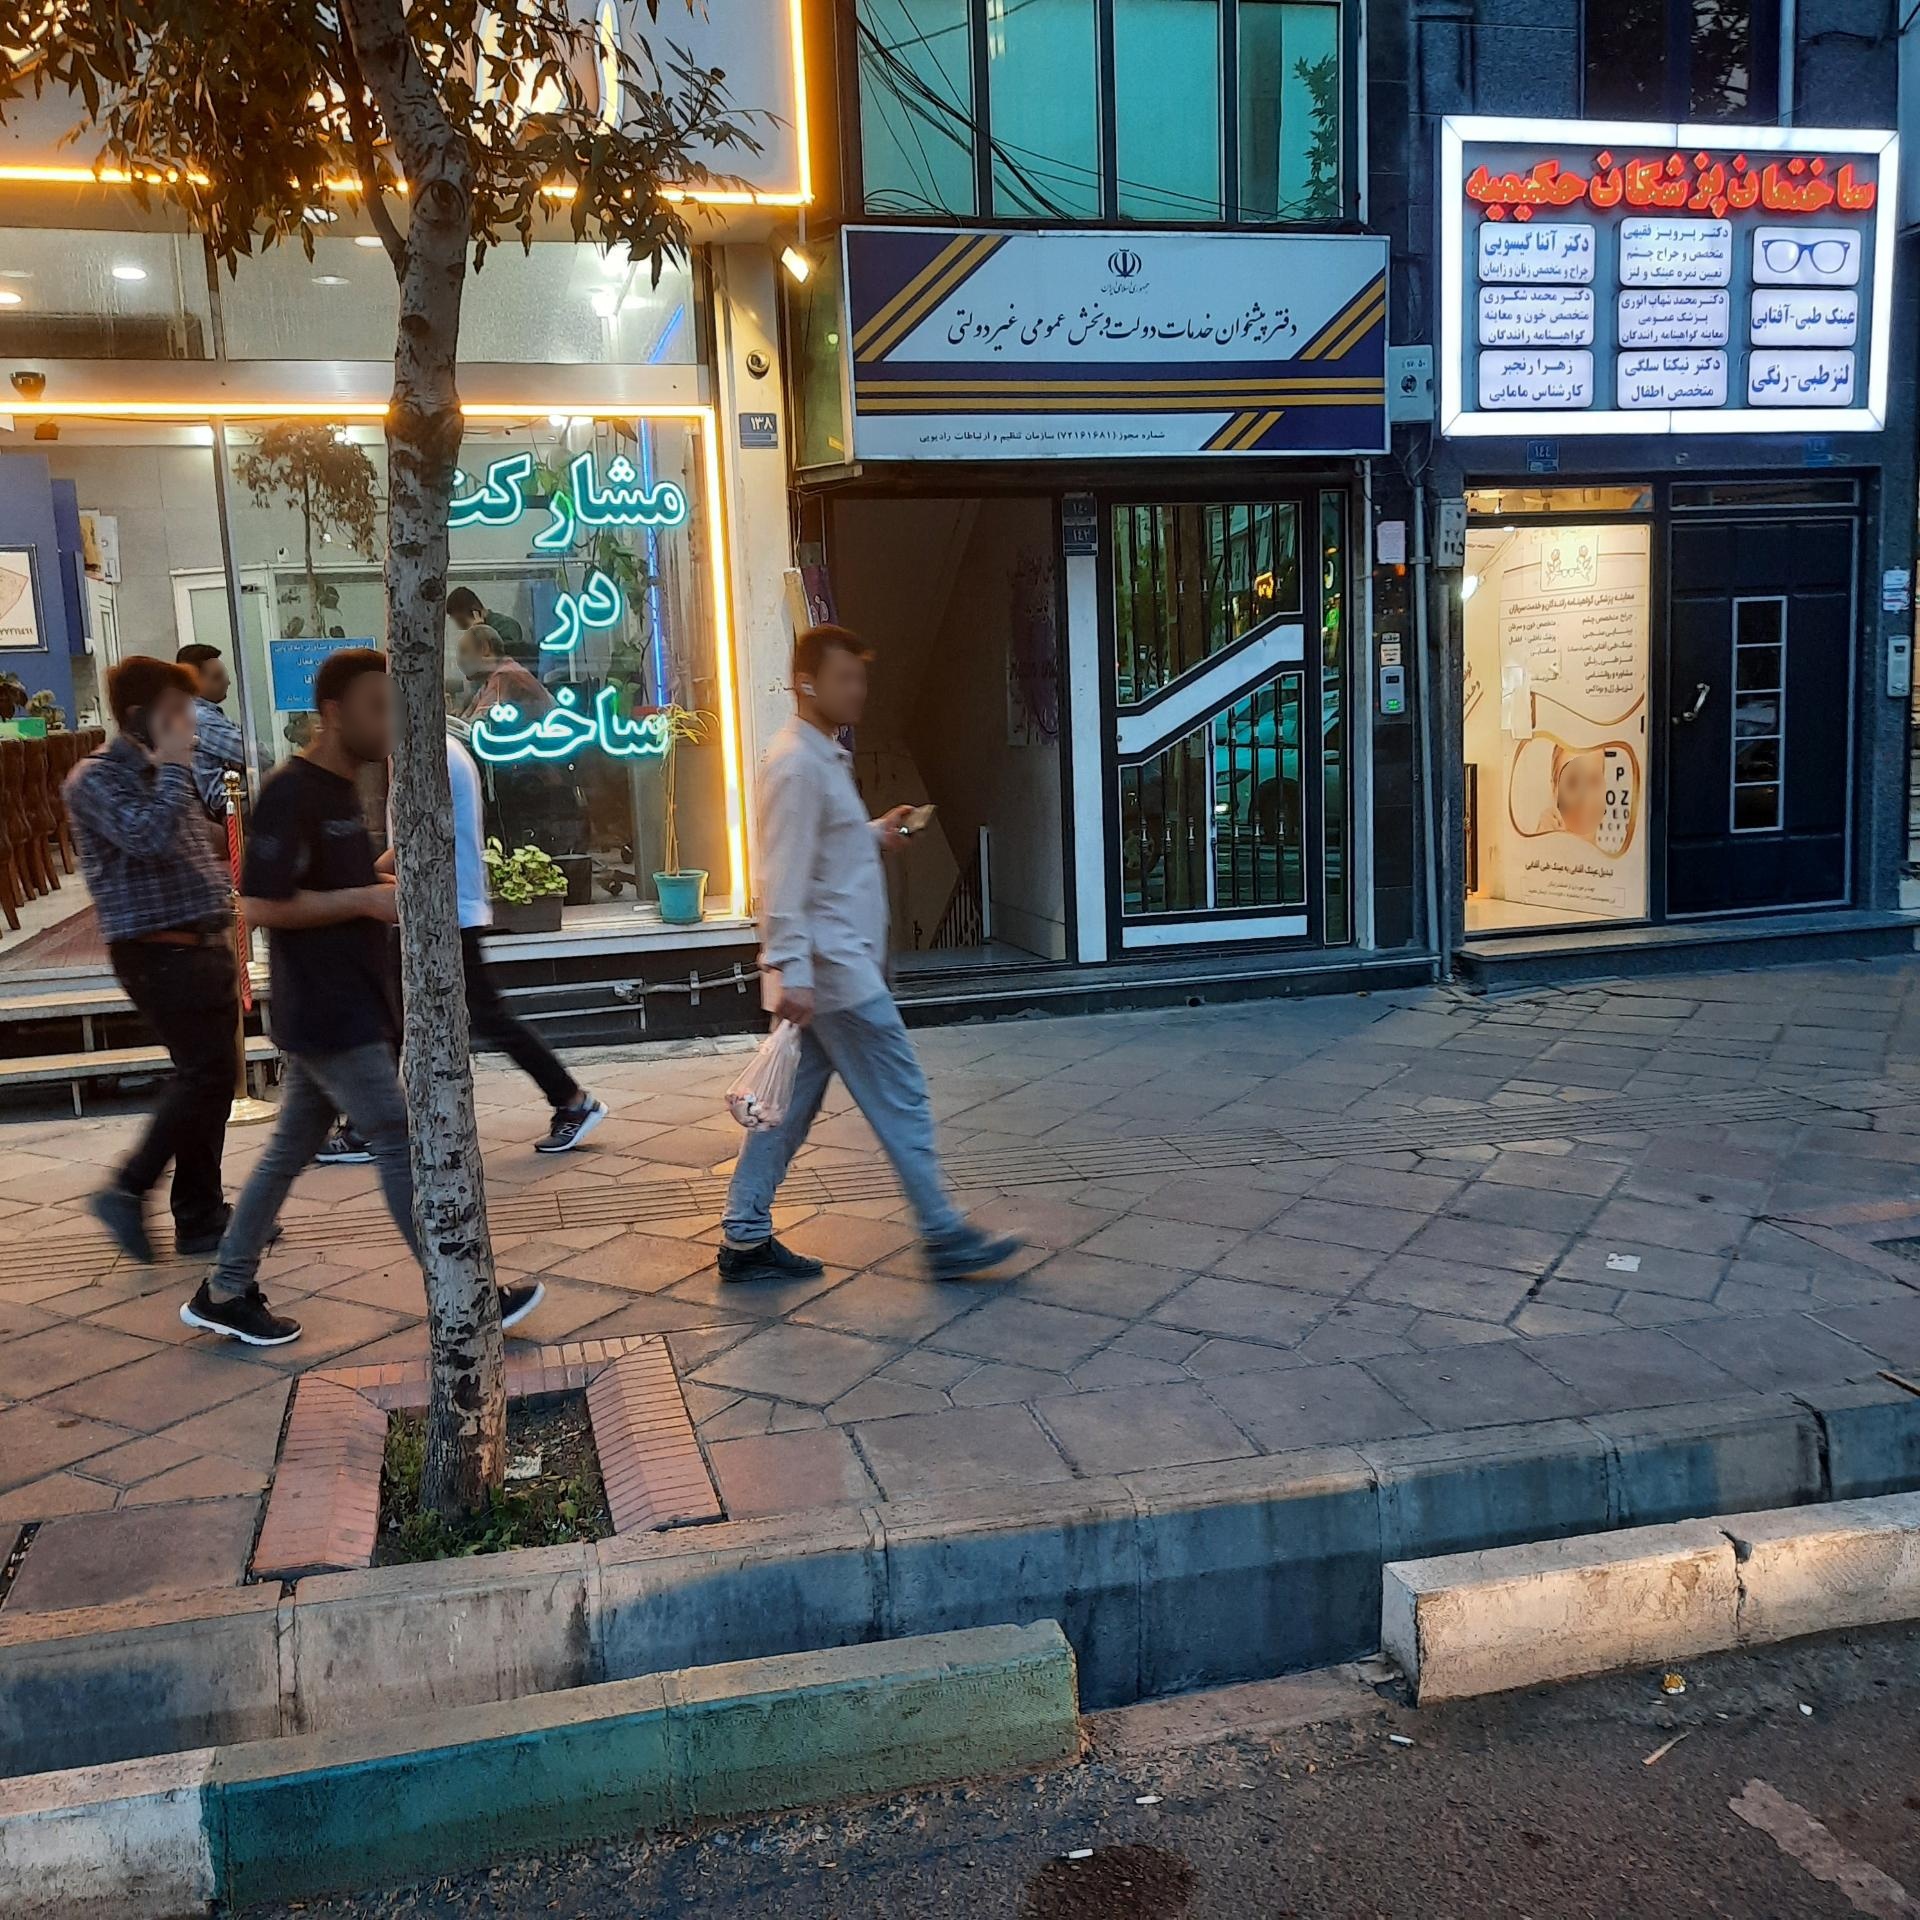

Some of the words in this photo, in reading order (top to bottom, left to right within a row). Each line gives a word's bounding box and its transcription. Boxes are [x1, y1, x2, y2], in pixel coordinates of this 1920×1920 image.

[1466, 159, 1588, 221] حکیمیه
[1589, 150, 1727, 219] پزشکان
[1727, 154, 1876, 213] ساختمان
[1623, 223, 1652, 240] فقیهی
[1655, 229, 1697, 242] پرویز
[1699, 226, 1729, 241] دکتر
[1484, 231, 1533, 257] گیسویی
[1561, 233, 1590, 258] دکتر
[1682, 251, 1688, 261] و
[1507, 266, 1513, 278] و
[1563, 267, 1568, 279] و
[1643, 269, 1649, 280] و
[1530, 293, 1558, 303] محمد
[1561, 289, 1591, 305] دکتر
[1673, 294, 1698, 305] محمد
[1697, 294, 1724, 308] دکتر
[1215, 302, 1268, 346] پیشخوان
[1516, 312, 1522, 324] و
[1523, 311, 1547, 324] خون
[1549, 308, 1590, 324] متخصص
[1638, 313, 1674, 326] عمومی
[1825, 306, 1855, 330] عینک
[1020, 313, 1066, 346] عمومی
[1105, 316, 1156, 340] دولت
[1158, 313, 1213, 340] خدمات
[1263, 308, 1297, 344] دفتر
[1501, 356, 1535, 376] رنجبر
[1537, 357, 1573, 375] زهرا
[1693, 356, 1721, 376] دکتر
[1489, 384, 1530, 402] مامایی
[1532, 384, 1584, 402] کارشناس
[1630, 384, 1665, 402] اطفال
[1667, 383, 1714, 402] متخصص
[750, 416, 773, 430] ۱۳۸
[992, 433, 998, 441] و
[1025, 431, 1055, 442] سازمان
[1119, 432, 1139, 441] مجوز
[1142, 430, 1165, 441] شماره
[539, 568, 623, 651] در
[471, 685, 669, 762] ساخت
